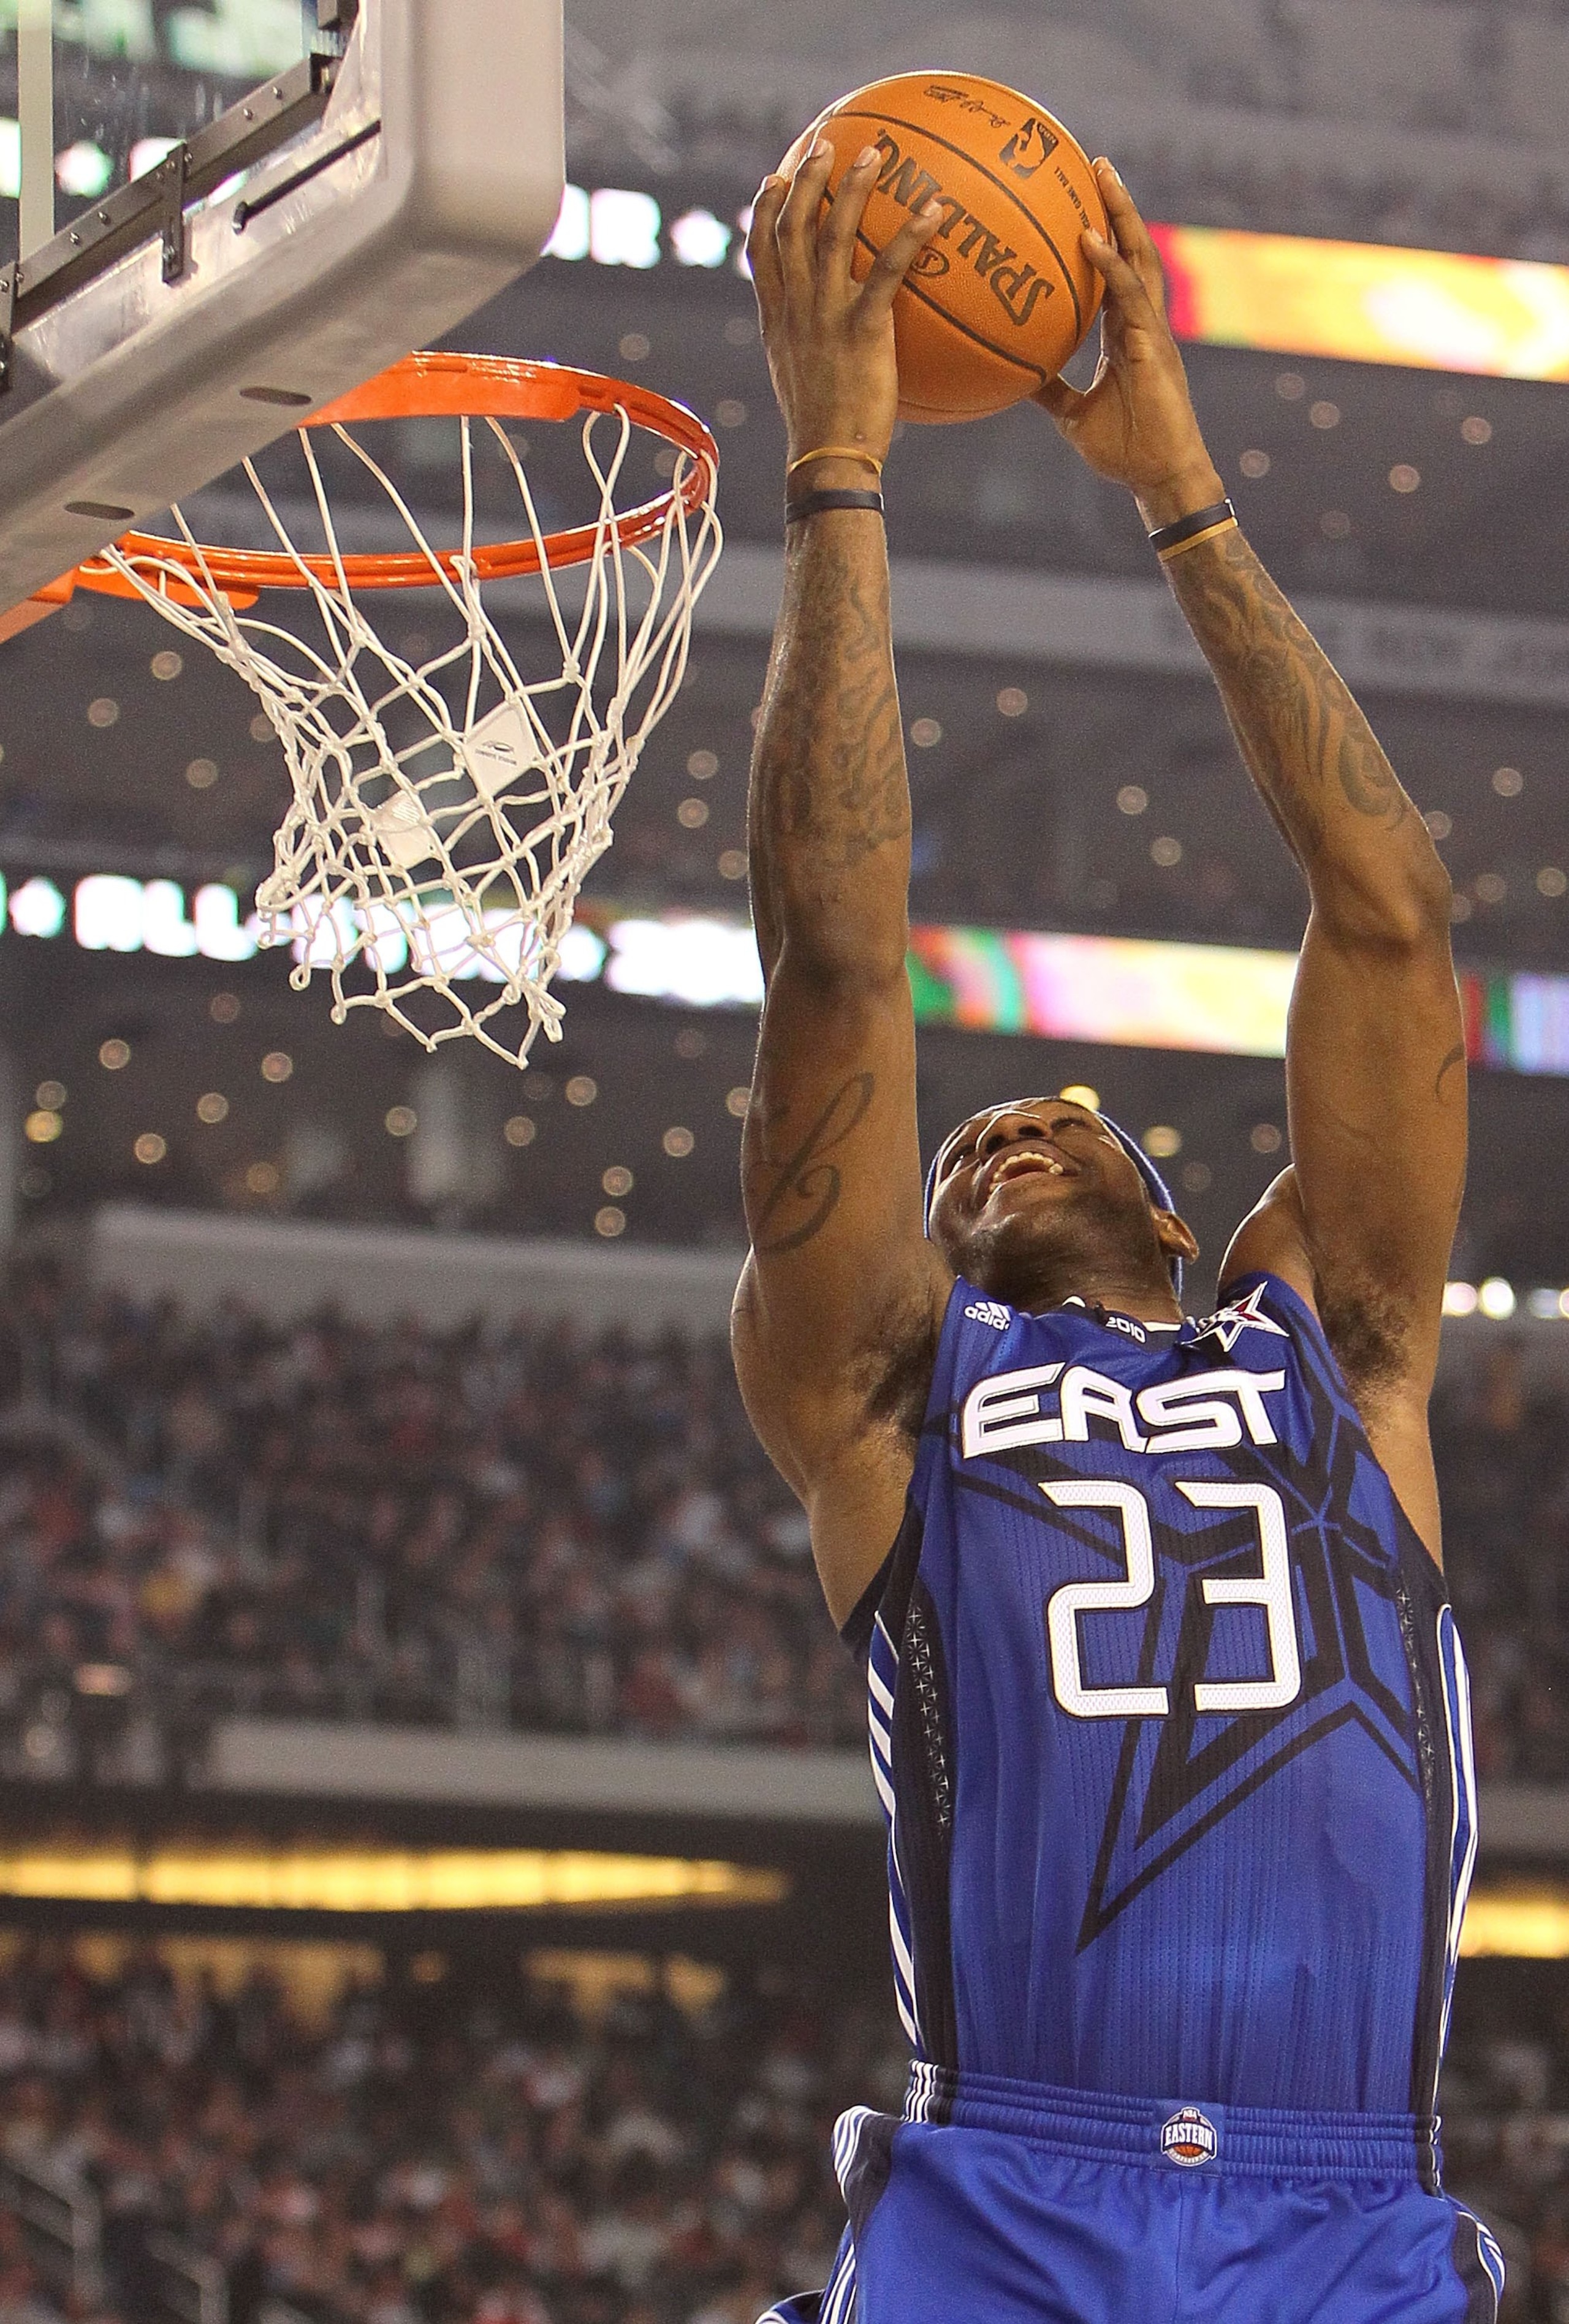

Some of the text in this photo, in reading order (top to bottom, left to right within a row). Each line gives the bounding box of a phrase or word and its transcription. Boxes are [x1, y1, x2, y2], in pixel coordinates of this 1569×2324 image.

[1105, 1315, 1146, 1344] 2010
[962, 1361, 1286, 1459] EAST
[1038, 1480, 1302, 1717] 23
[1164, 2122, 1214, 2151] EASTERN
